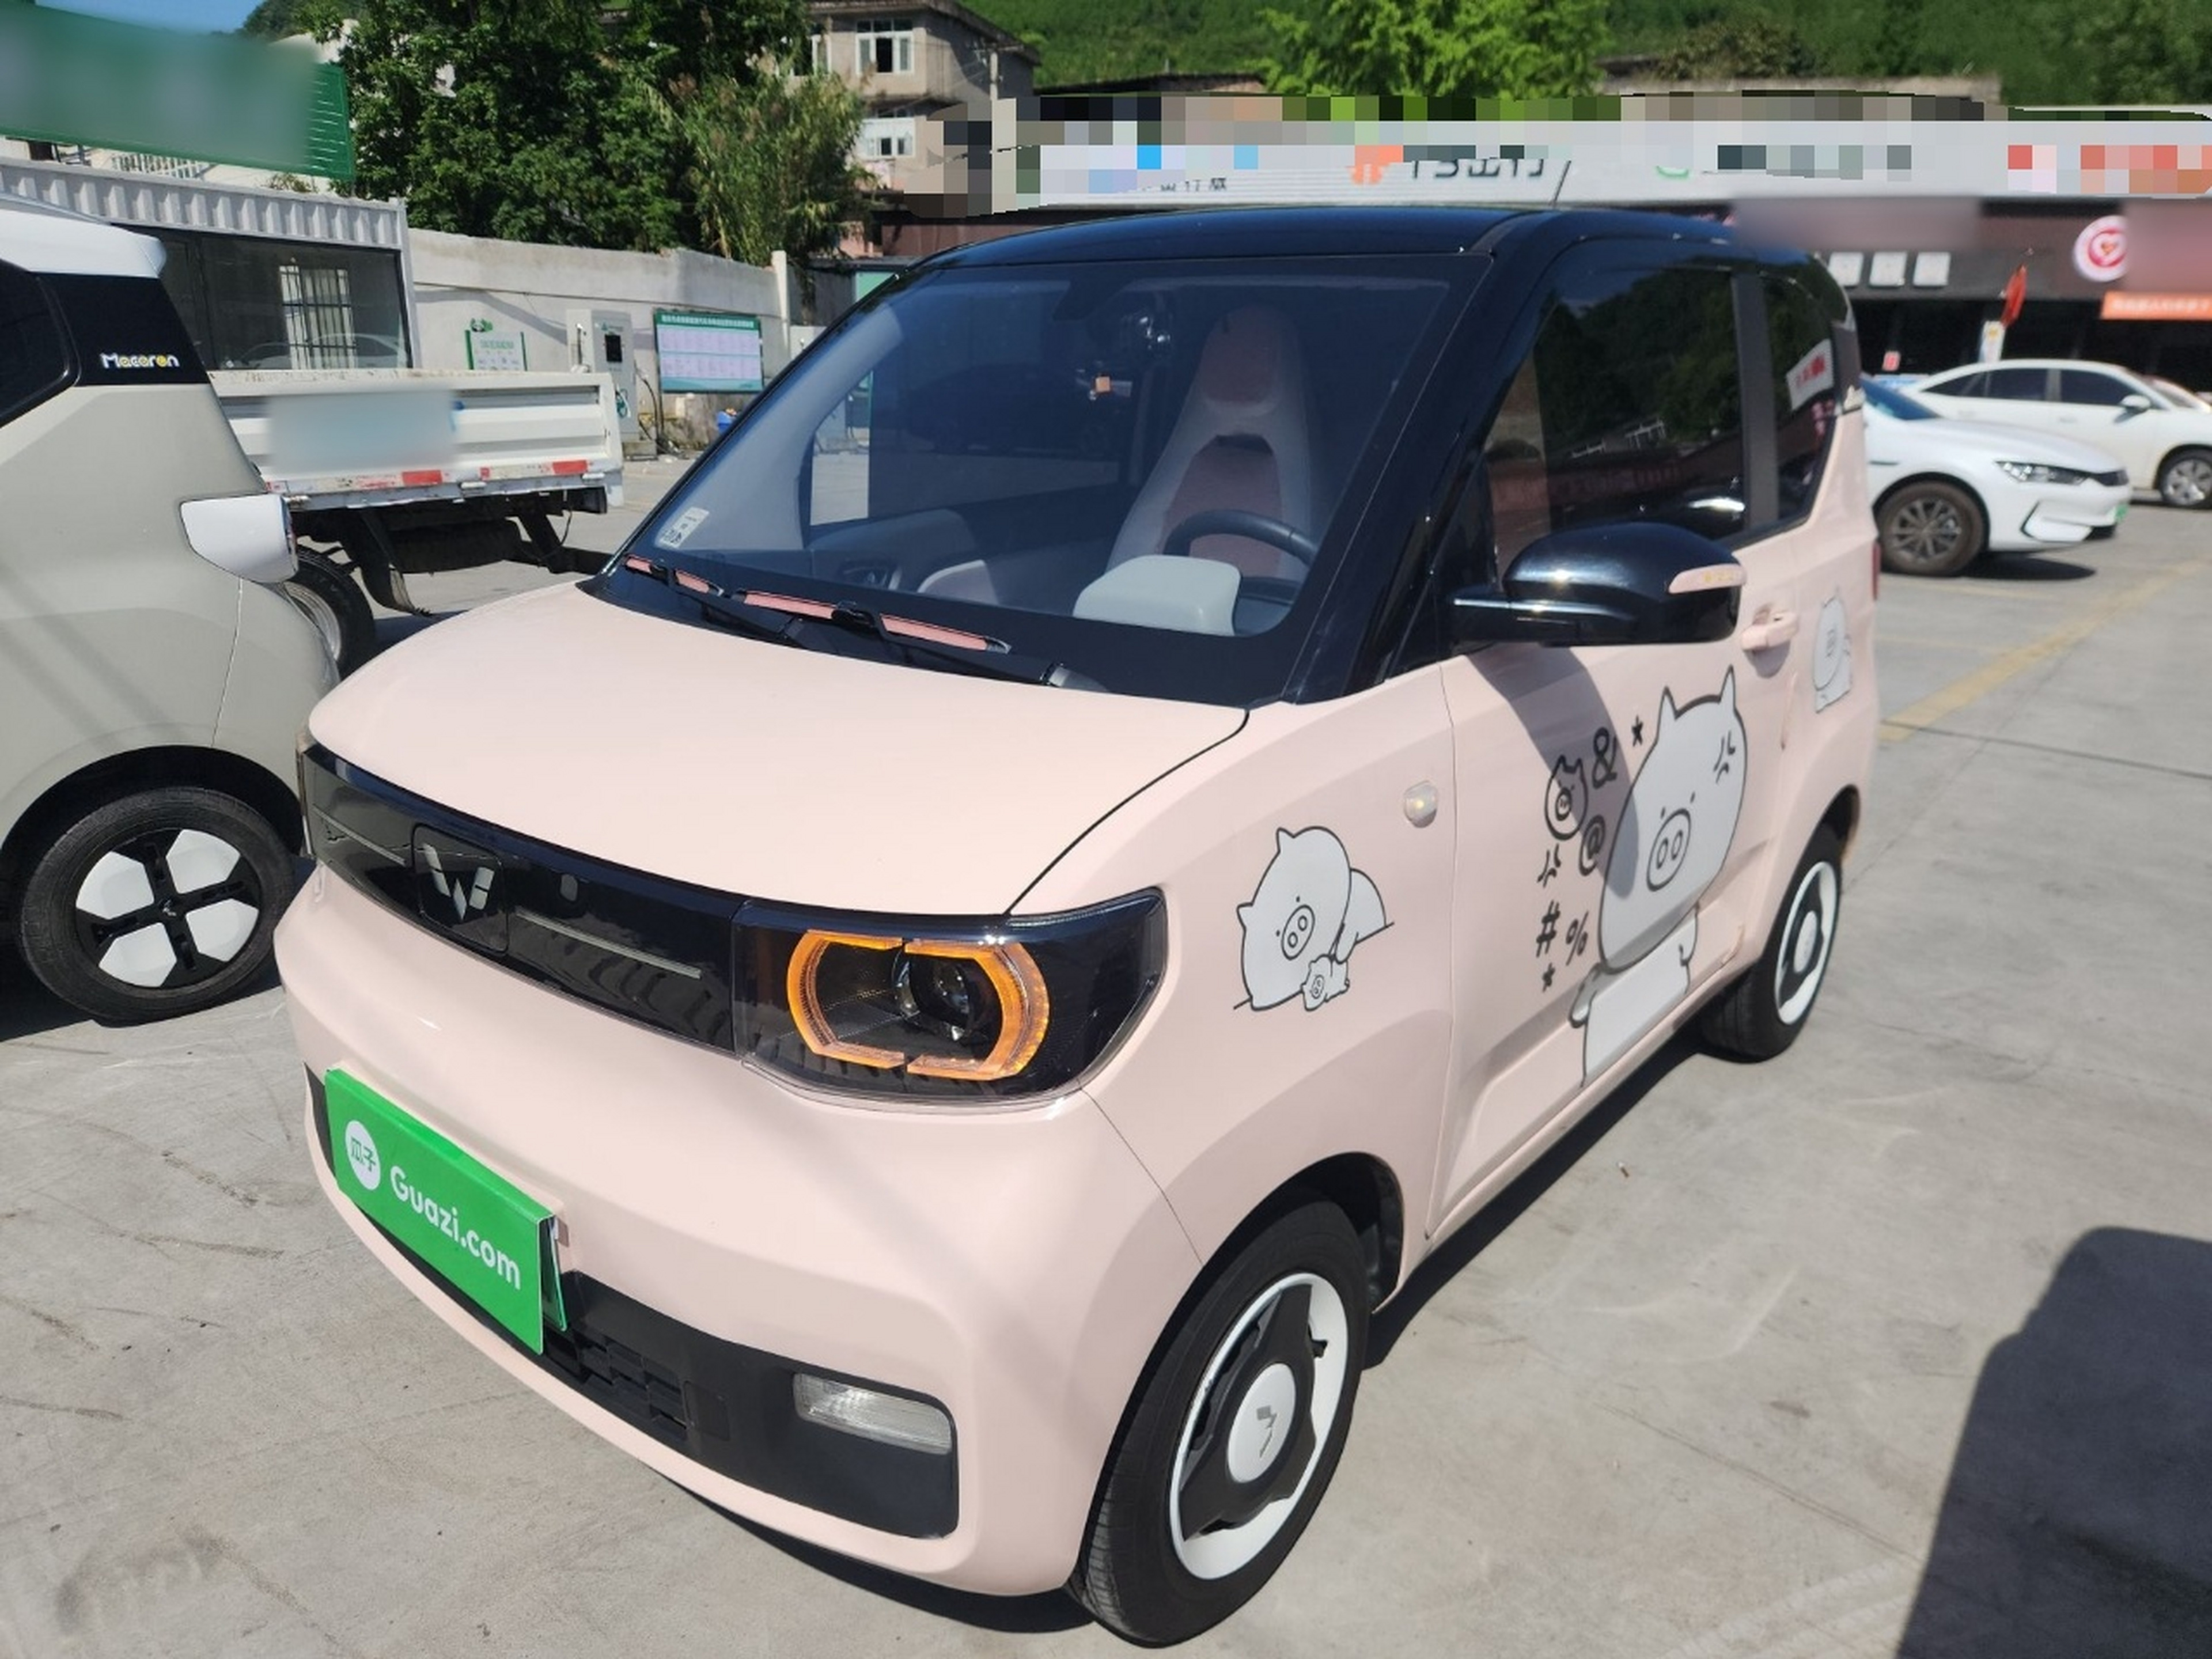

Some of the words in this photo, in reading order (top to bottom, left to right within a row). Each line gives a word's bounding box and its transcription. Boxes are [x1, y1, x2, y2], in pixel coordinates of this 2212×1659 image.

[100, 353, 180, 368] Macaron
[351, 1138, 376, 1172] 瓜子
[390, 1165, 521, 1290] Guazi.com
